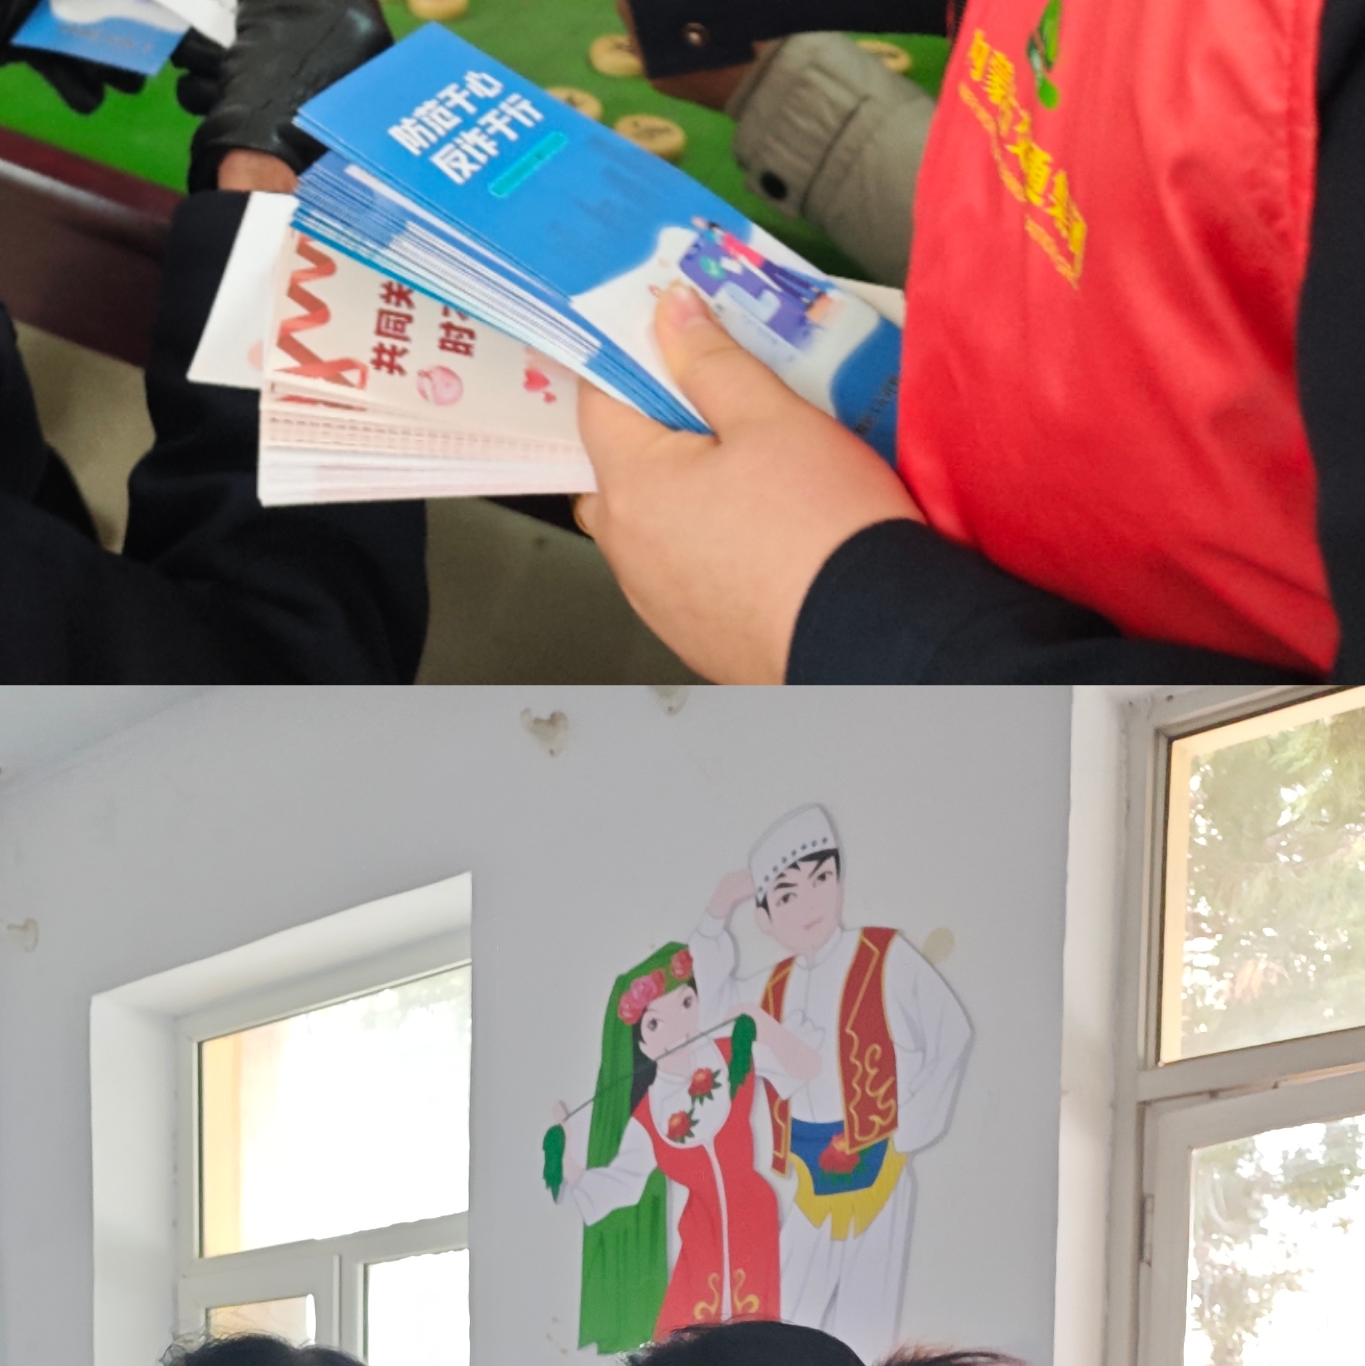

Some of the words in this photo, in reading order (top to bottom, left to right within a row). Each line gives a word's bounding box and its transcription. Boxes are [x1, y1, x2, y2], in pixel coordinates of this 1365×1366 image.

[387, 71, 504, 156] 防范于心
[429, 93, 545, 185] 反诈于行
